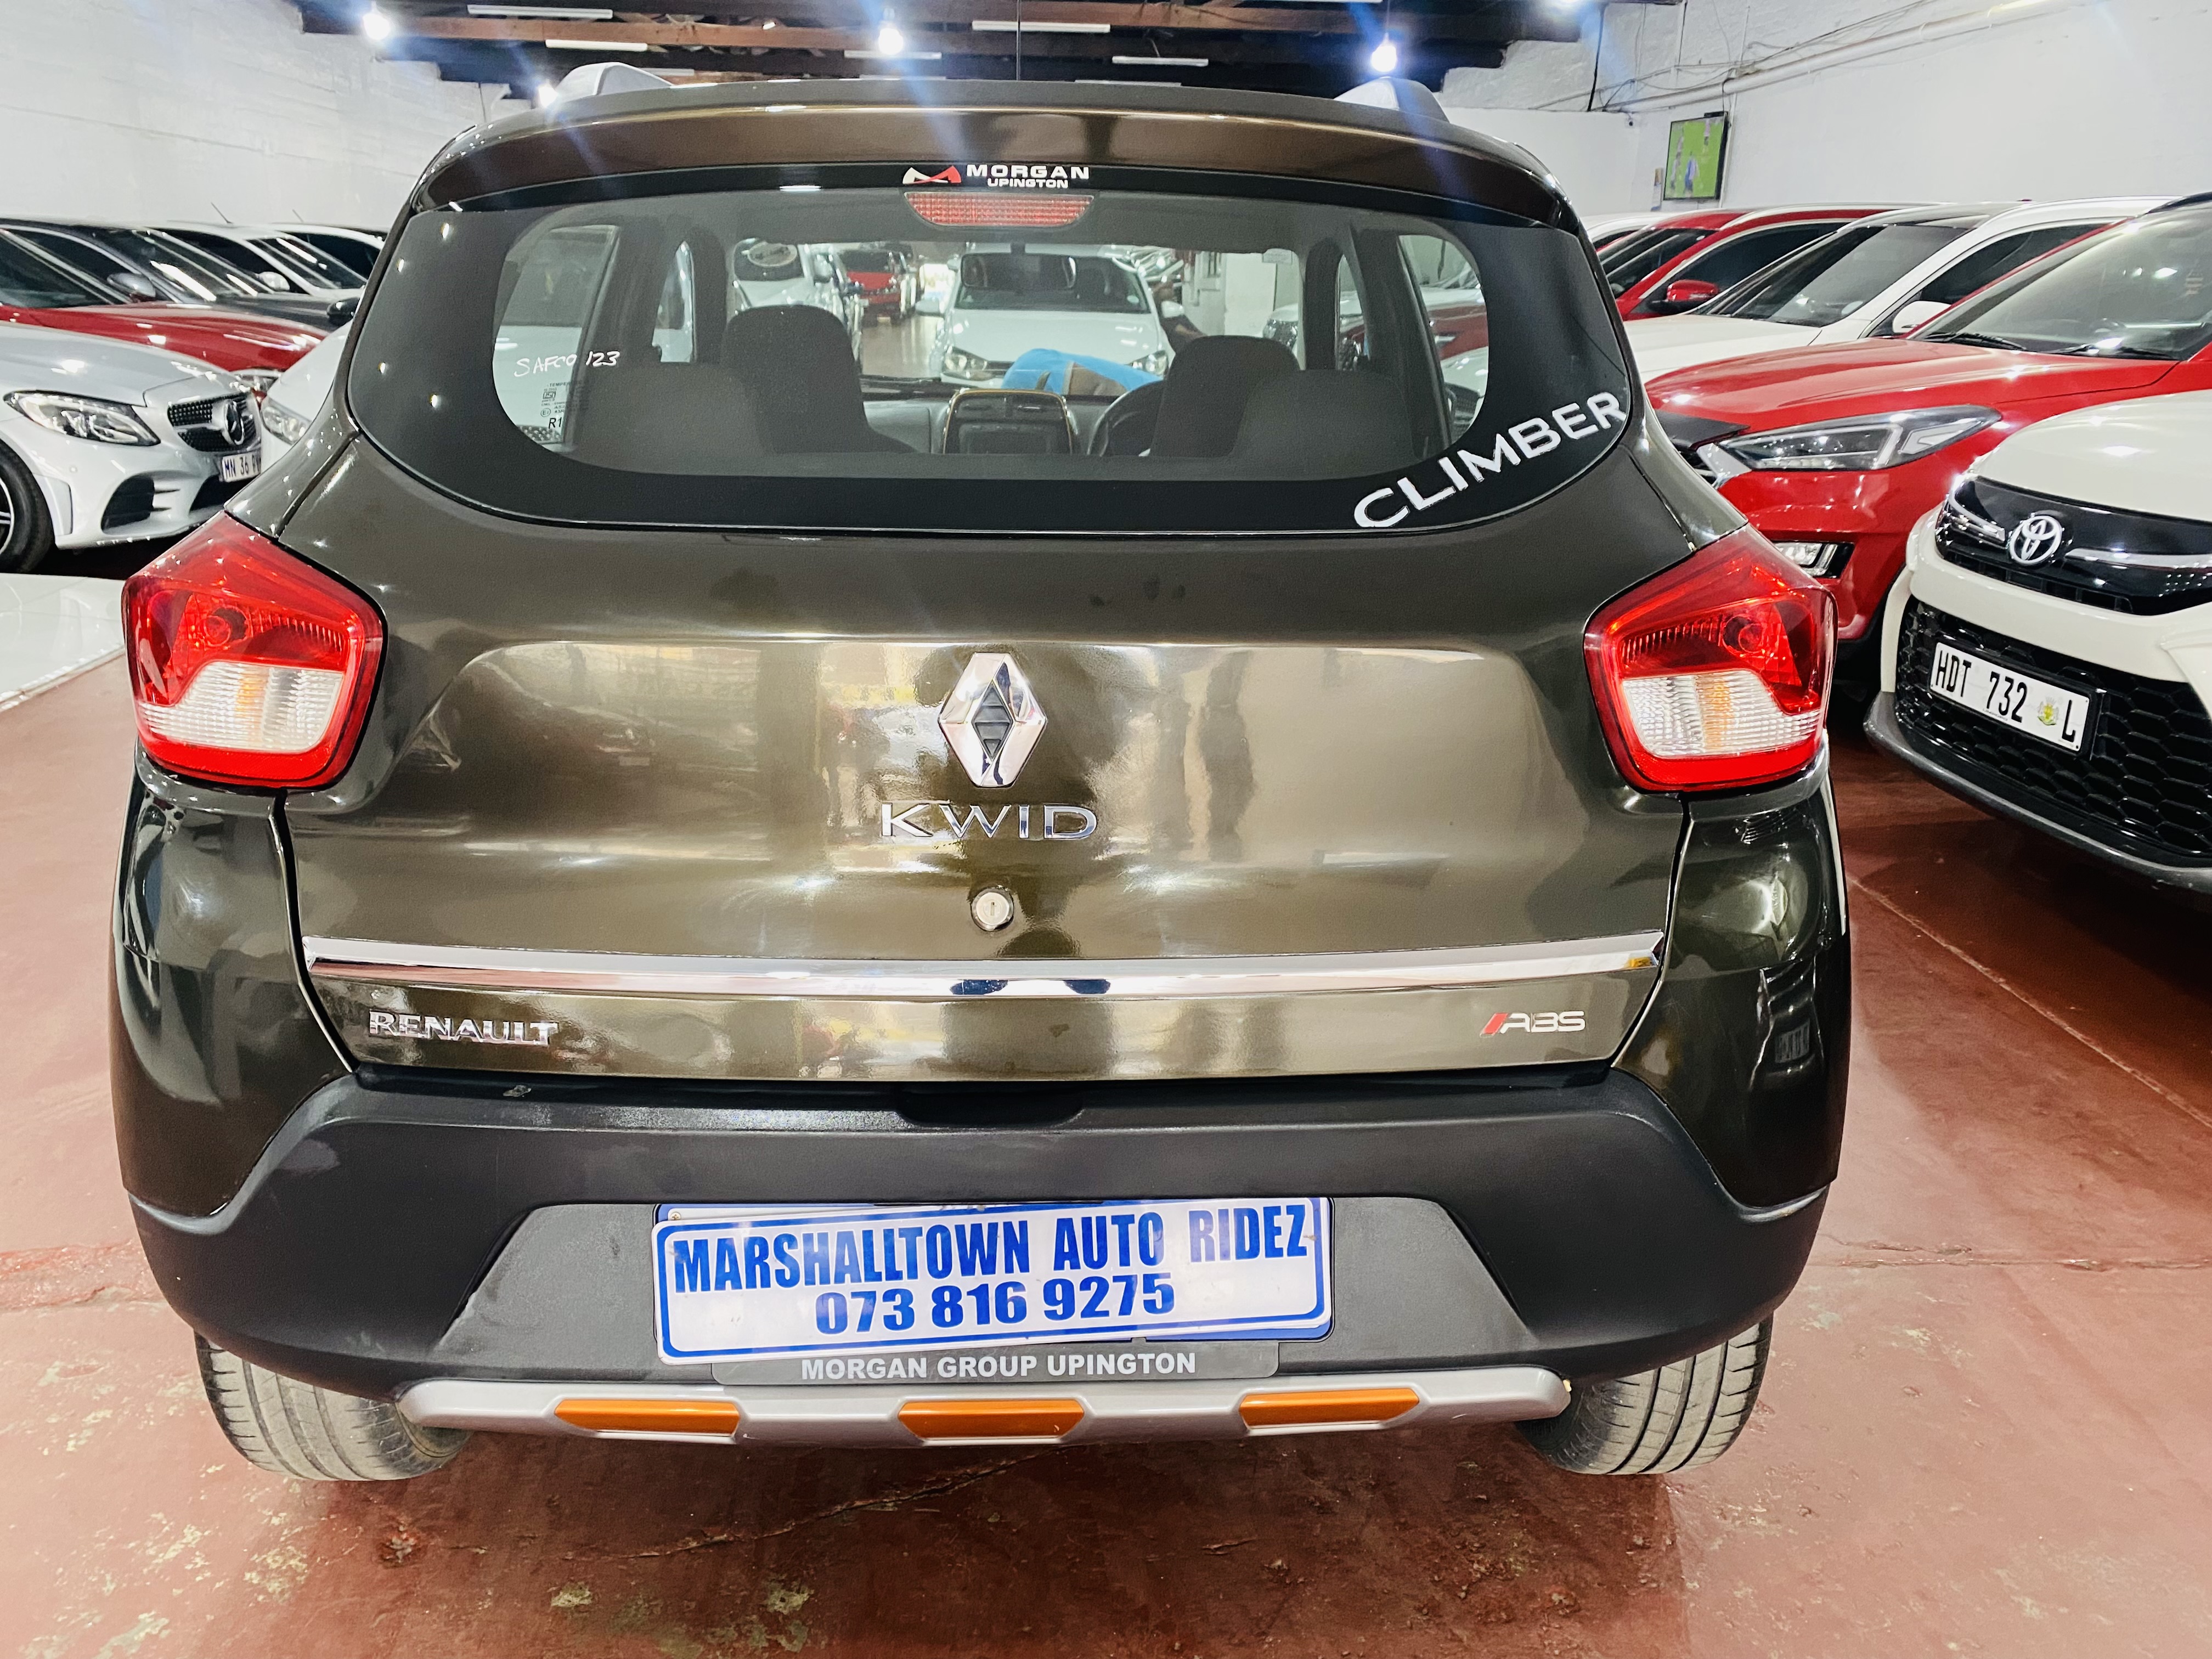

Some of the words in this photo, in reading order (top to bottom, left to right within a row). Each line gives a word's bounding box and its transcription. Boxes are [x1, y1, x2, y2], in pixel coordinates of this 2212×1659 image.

[966, 163, 1090, 179] MORGAN
[987, 178, 1069, 189] UPINGTON
[585, 351, 620, 367] 123
[224, 458, 236, 477] MN
[240, 456, 249, 475] 36
[1353, 392, 1627, 528] CLIMBER
[1936, 650, 1972, 697] HDT
[1986, 670, 2028, 723] 732
[2062, 699, 2076, 742] L
[881, 802, 1097, 839] KWID
[369, 1009, 558, 1046] RENAULT
[673, 1220, 1030, 1293] MARSHALLTOWN
[1053, 1211, 1164, 1271] AUTO
[1188, 1204, 1308, 1262] RIDEZ
[815, 1288, 915, 1335] 073
[932, 1281, 1027, 1328] 816
[1043, 1272, 1175, 1321] 9275
[802, 1357, 927, 1380] MORGAN
[937, 1355, 1037, 1378] GROUP
[1047, 1352, 1196, 1377] UPINGTON
